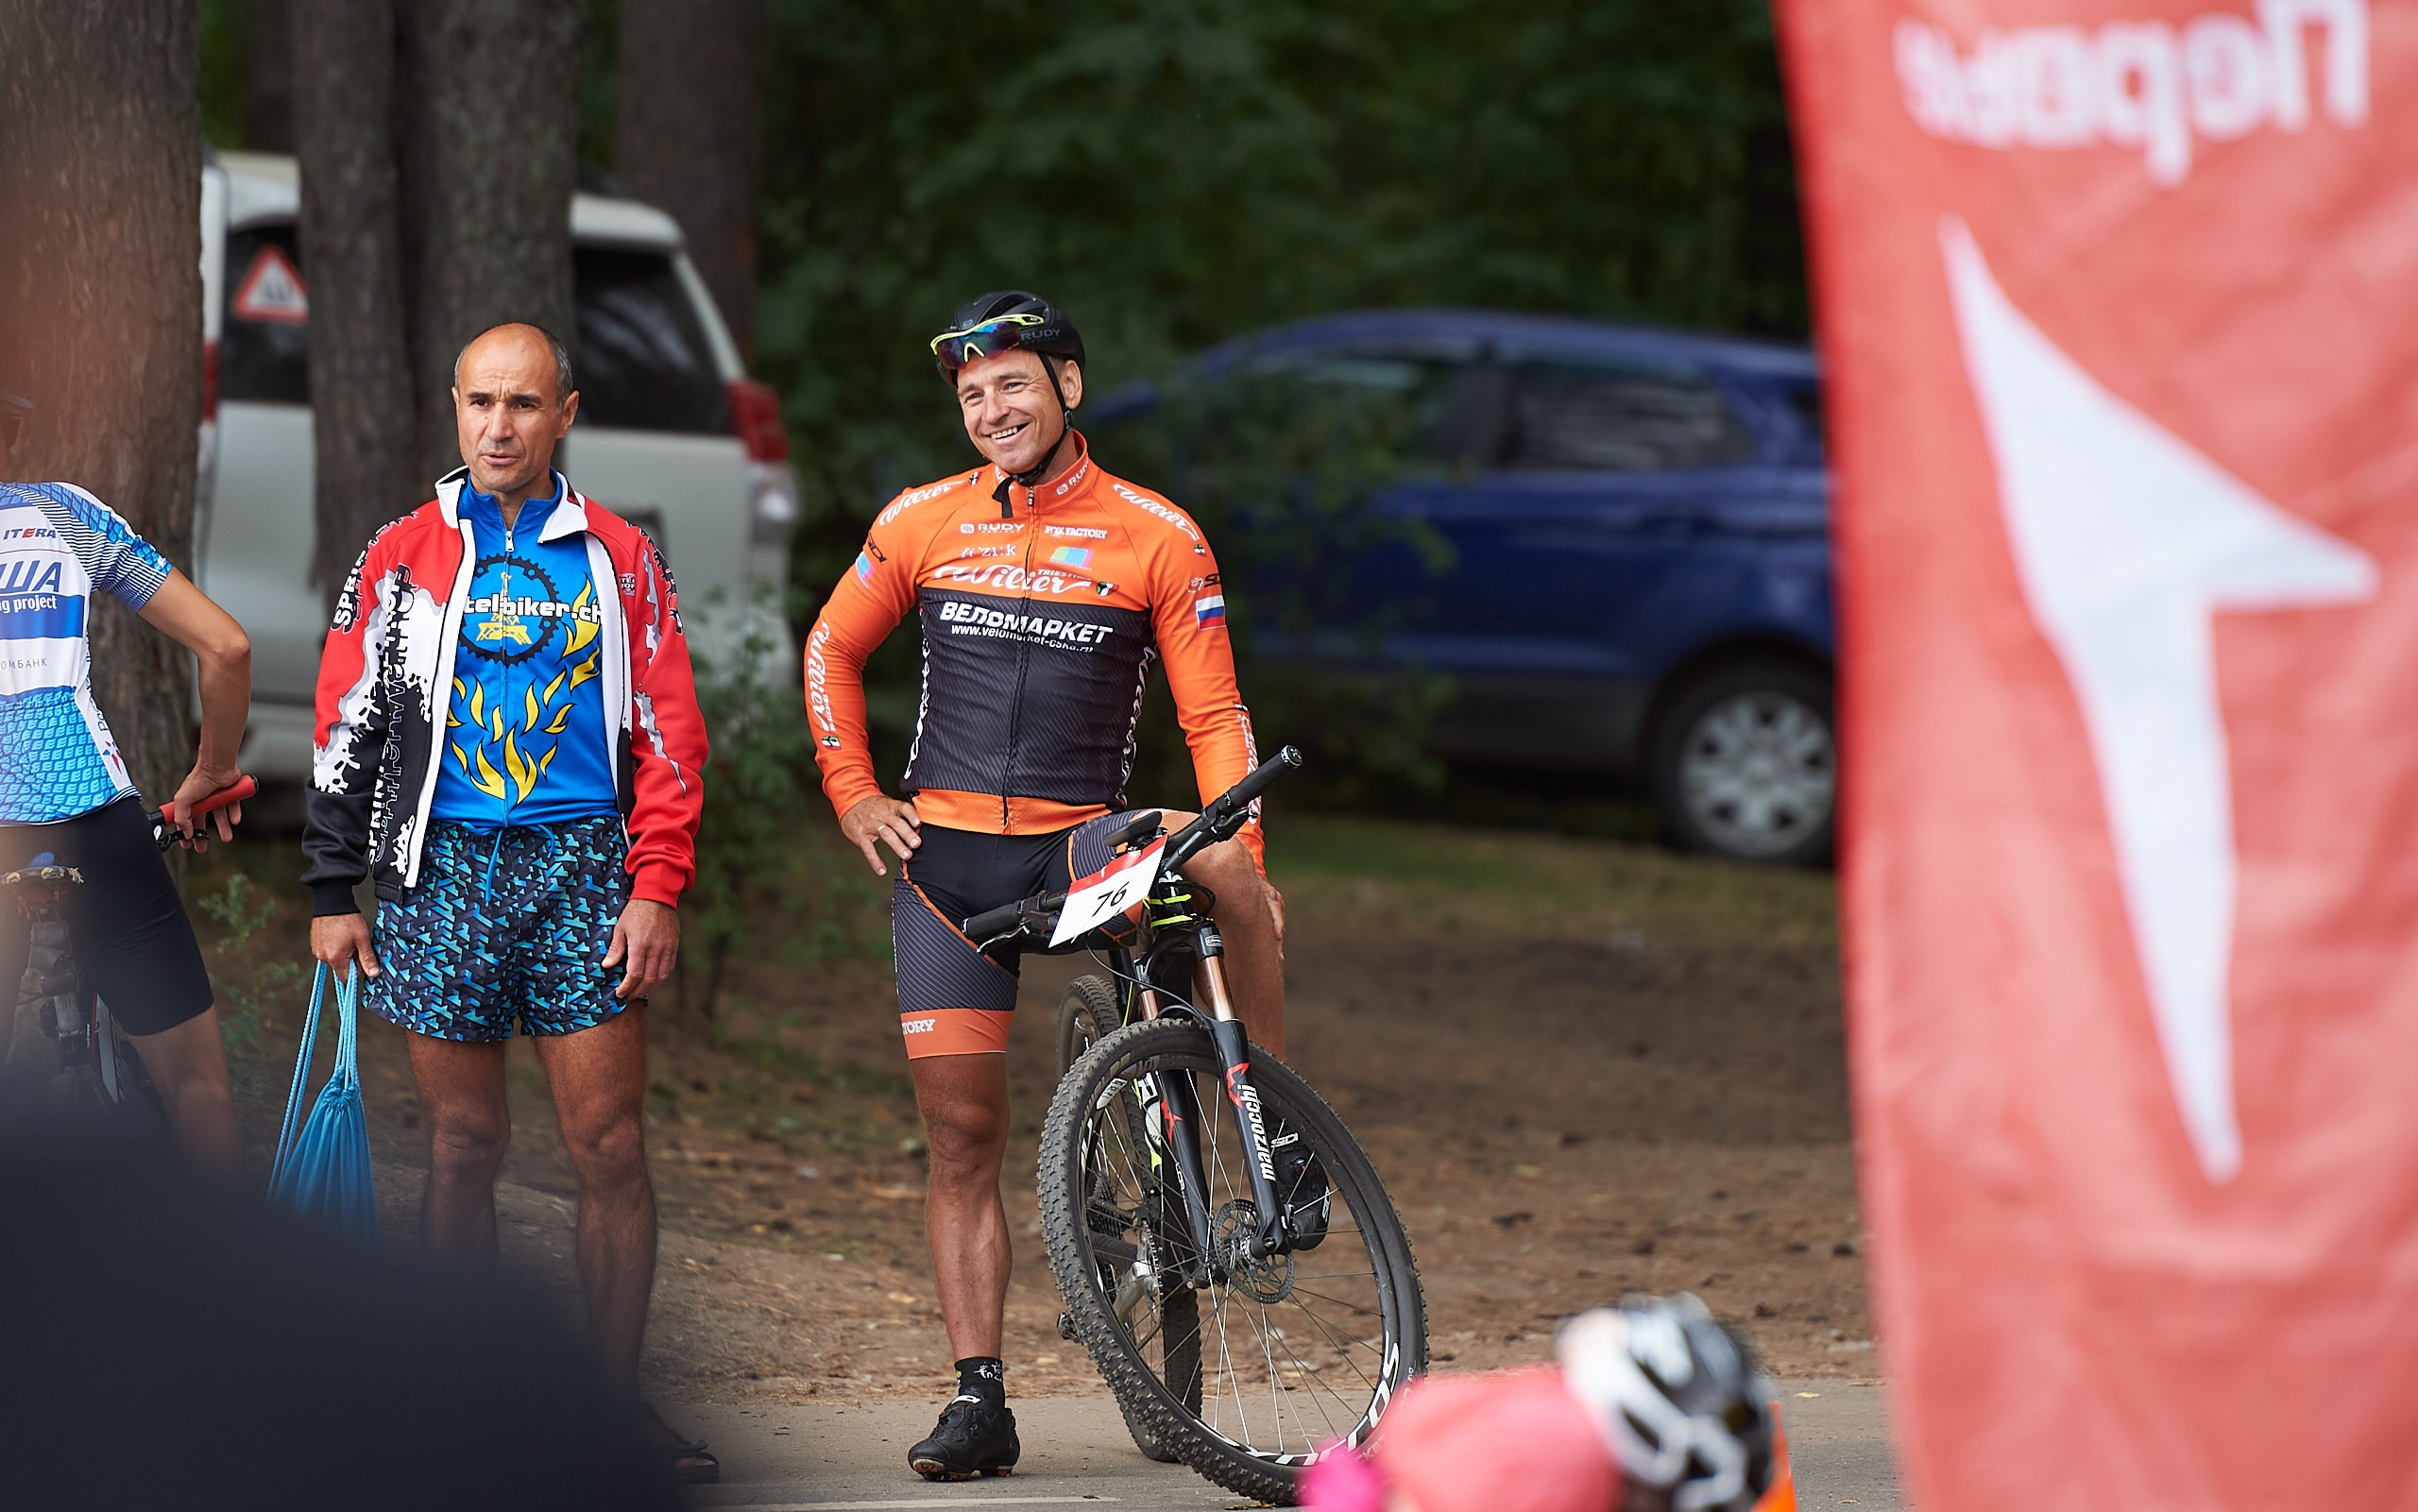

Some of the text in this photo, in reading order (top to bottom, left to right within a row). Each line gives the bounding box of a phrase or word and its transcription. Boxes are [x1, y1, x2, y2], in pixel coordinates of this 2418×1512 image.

[1020, 329, 1061, 342] RUDY
[3, 528, 57, 540] ITERA
[978, 523, 1025, 532] RUDY
[1065, 526, 1108, 539] FACTORY
[933, 564, 1092, 594] Wilier
[13, 595, 57, 614] project
[939, 601, 1114, 645] ВЕЛОМАРКЕТ
[1092, 880, 1130, 918] 76
[1237, 1084, 1276, 1181] marzocchi
